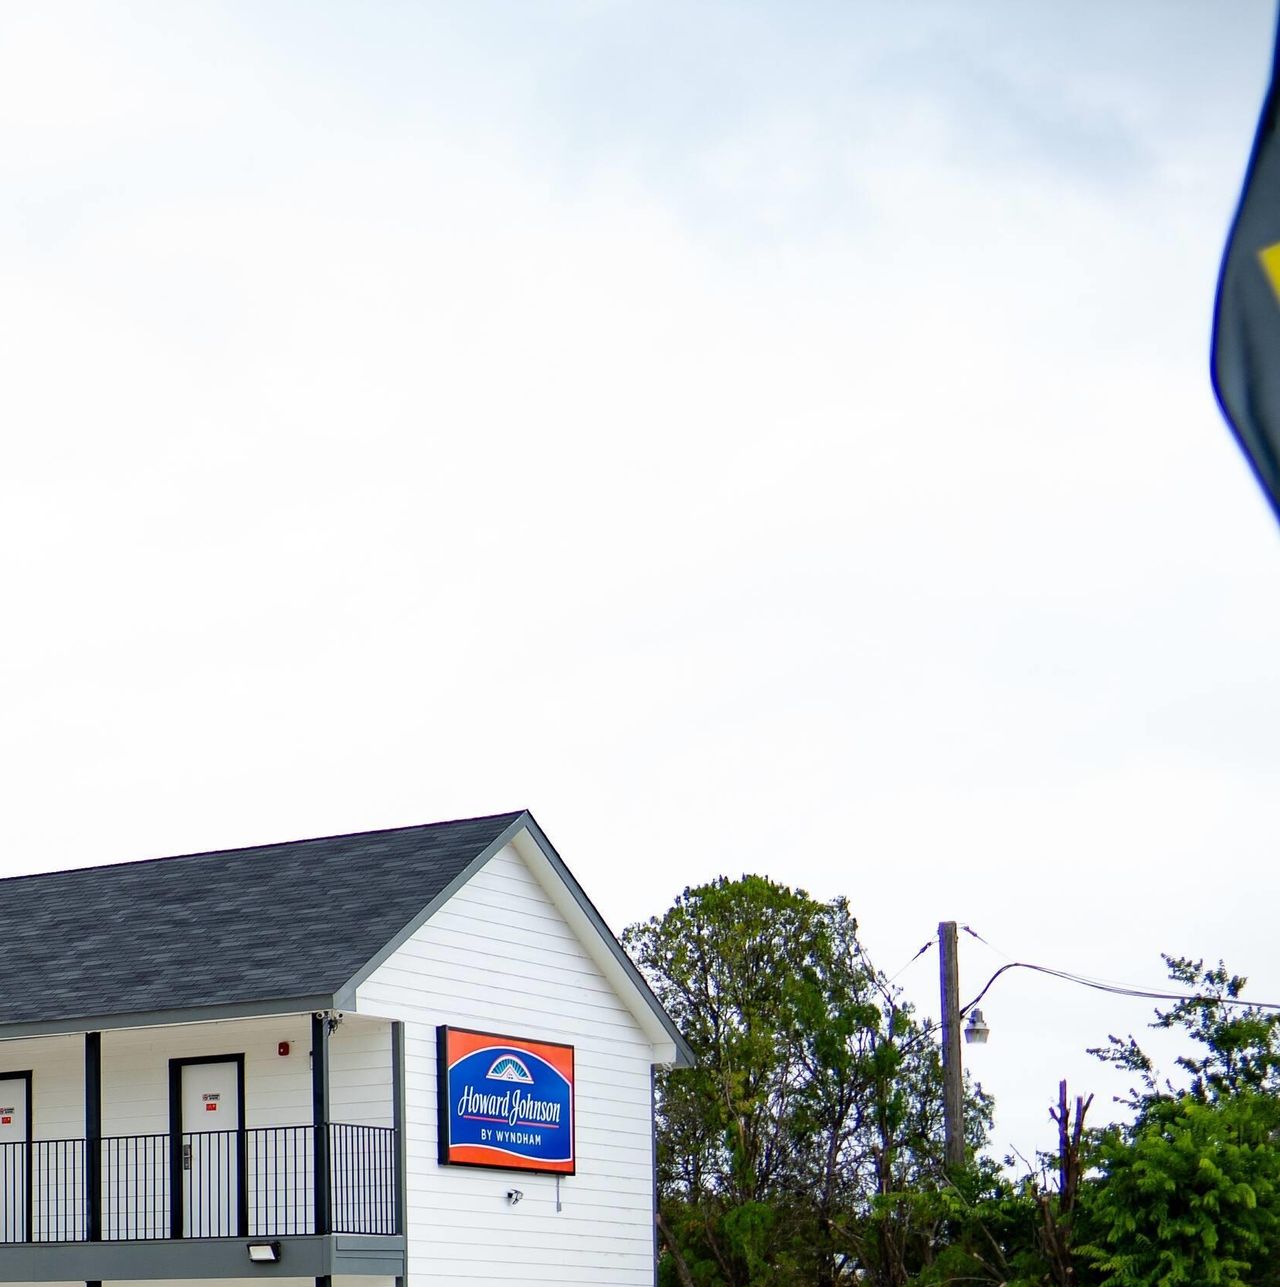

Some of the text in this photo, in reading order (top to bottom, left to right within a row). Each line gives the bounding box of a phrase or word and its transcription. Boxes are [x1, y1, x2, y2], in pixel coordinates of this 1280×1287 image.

[458, 1085, 560, 1126] Howard Johnson
[481, 1128, 542, 1146] BY WYNDHAM
